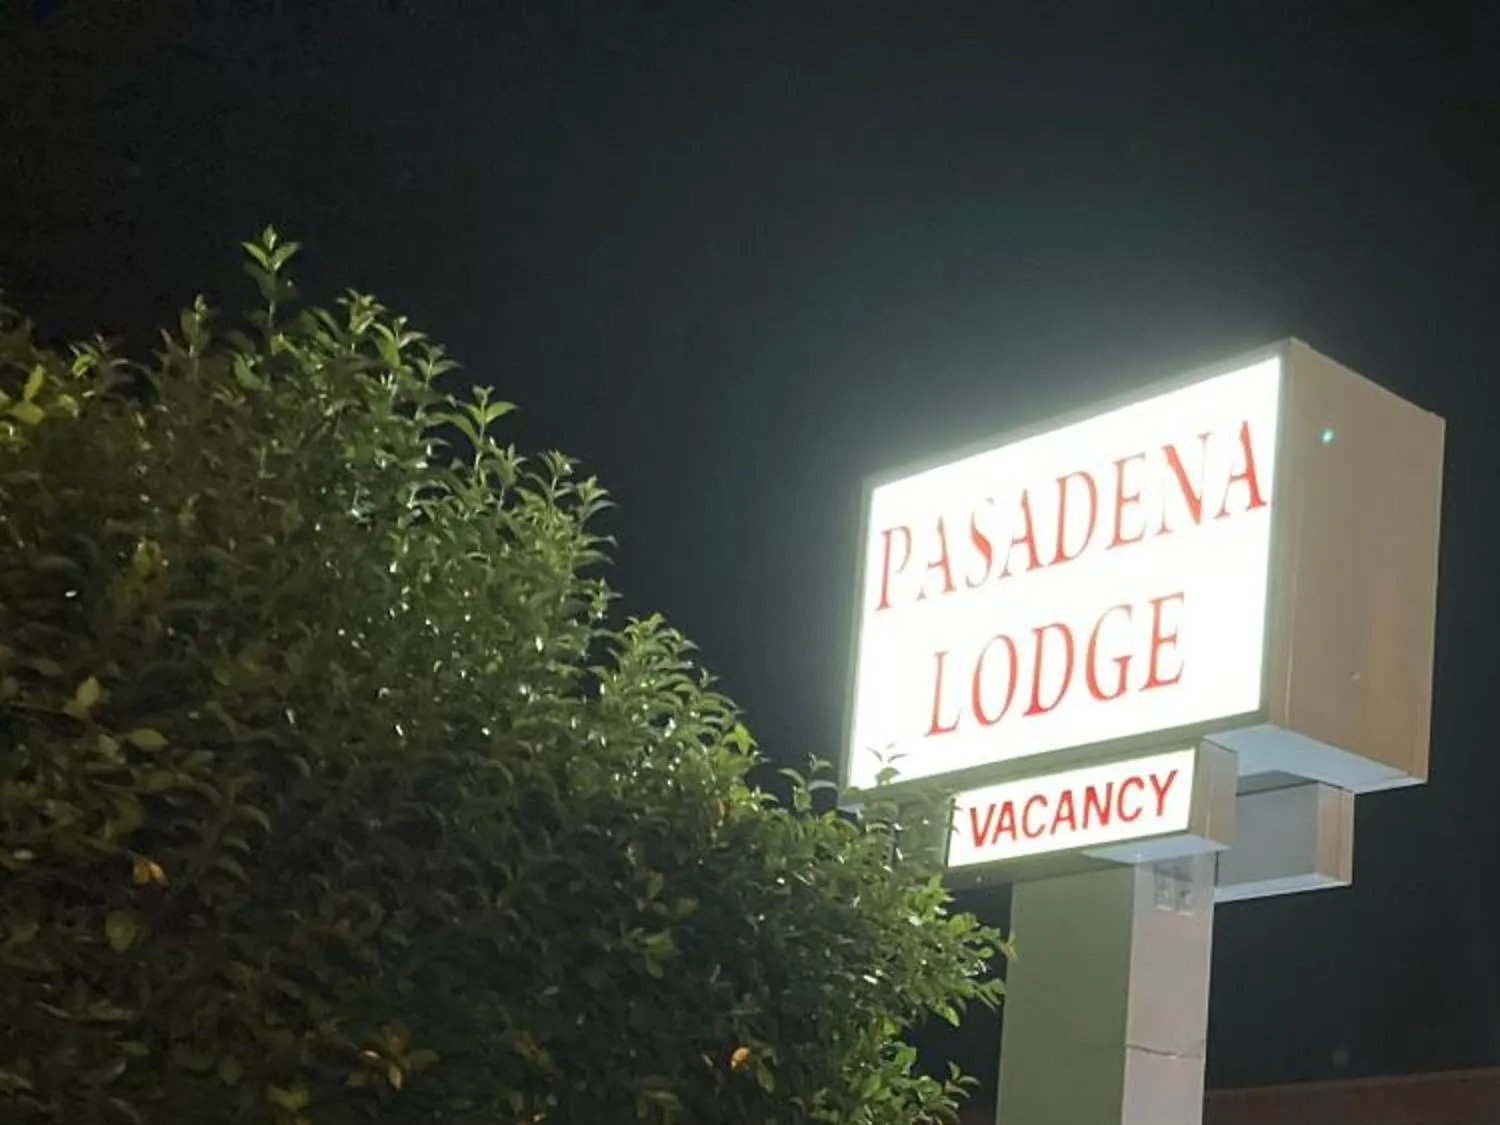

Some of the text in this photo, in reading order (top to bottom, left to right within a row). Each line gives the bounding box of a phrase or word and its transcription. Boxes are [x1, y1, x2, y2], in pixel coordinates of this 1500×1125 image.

[875, 420, 1267, 612] PASADENA
[925, 591, 1186, 738] LODGE
[968, 768, 1179, 848] VACANCY
